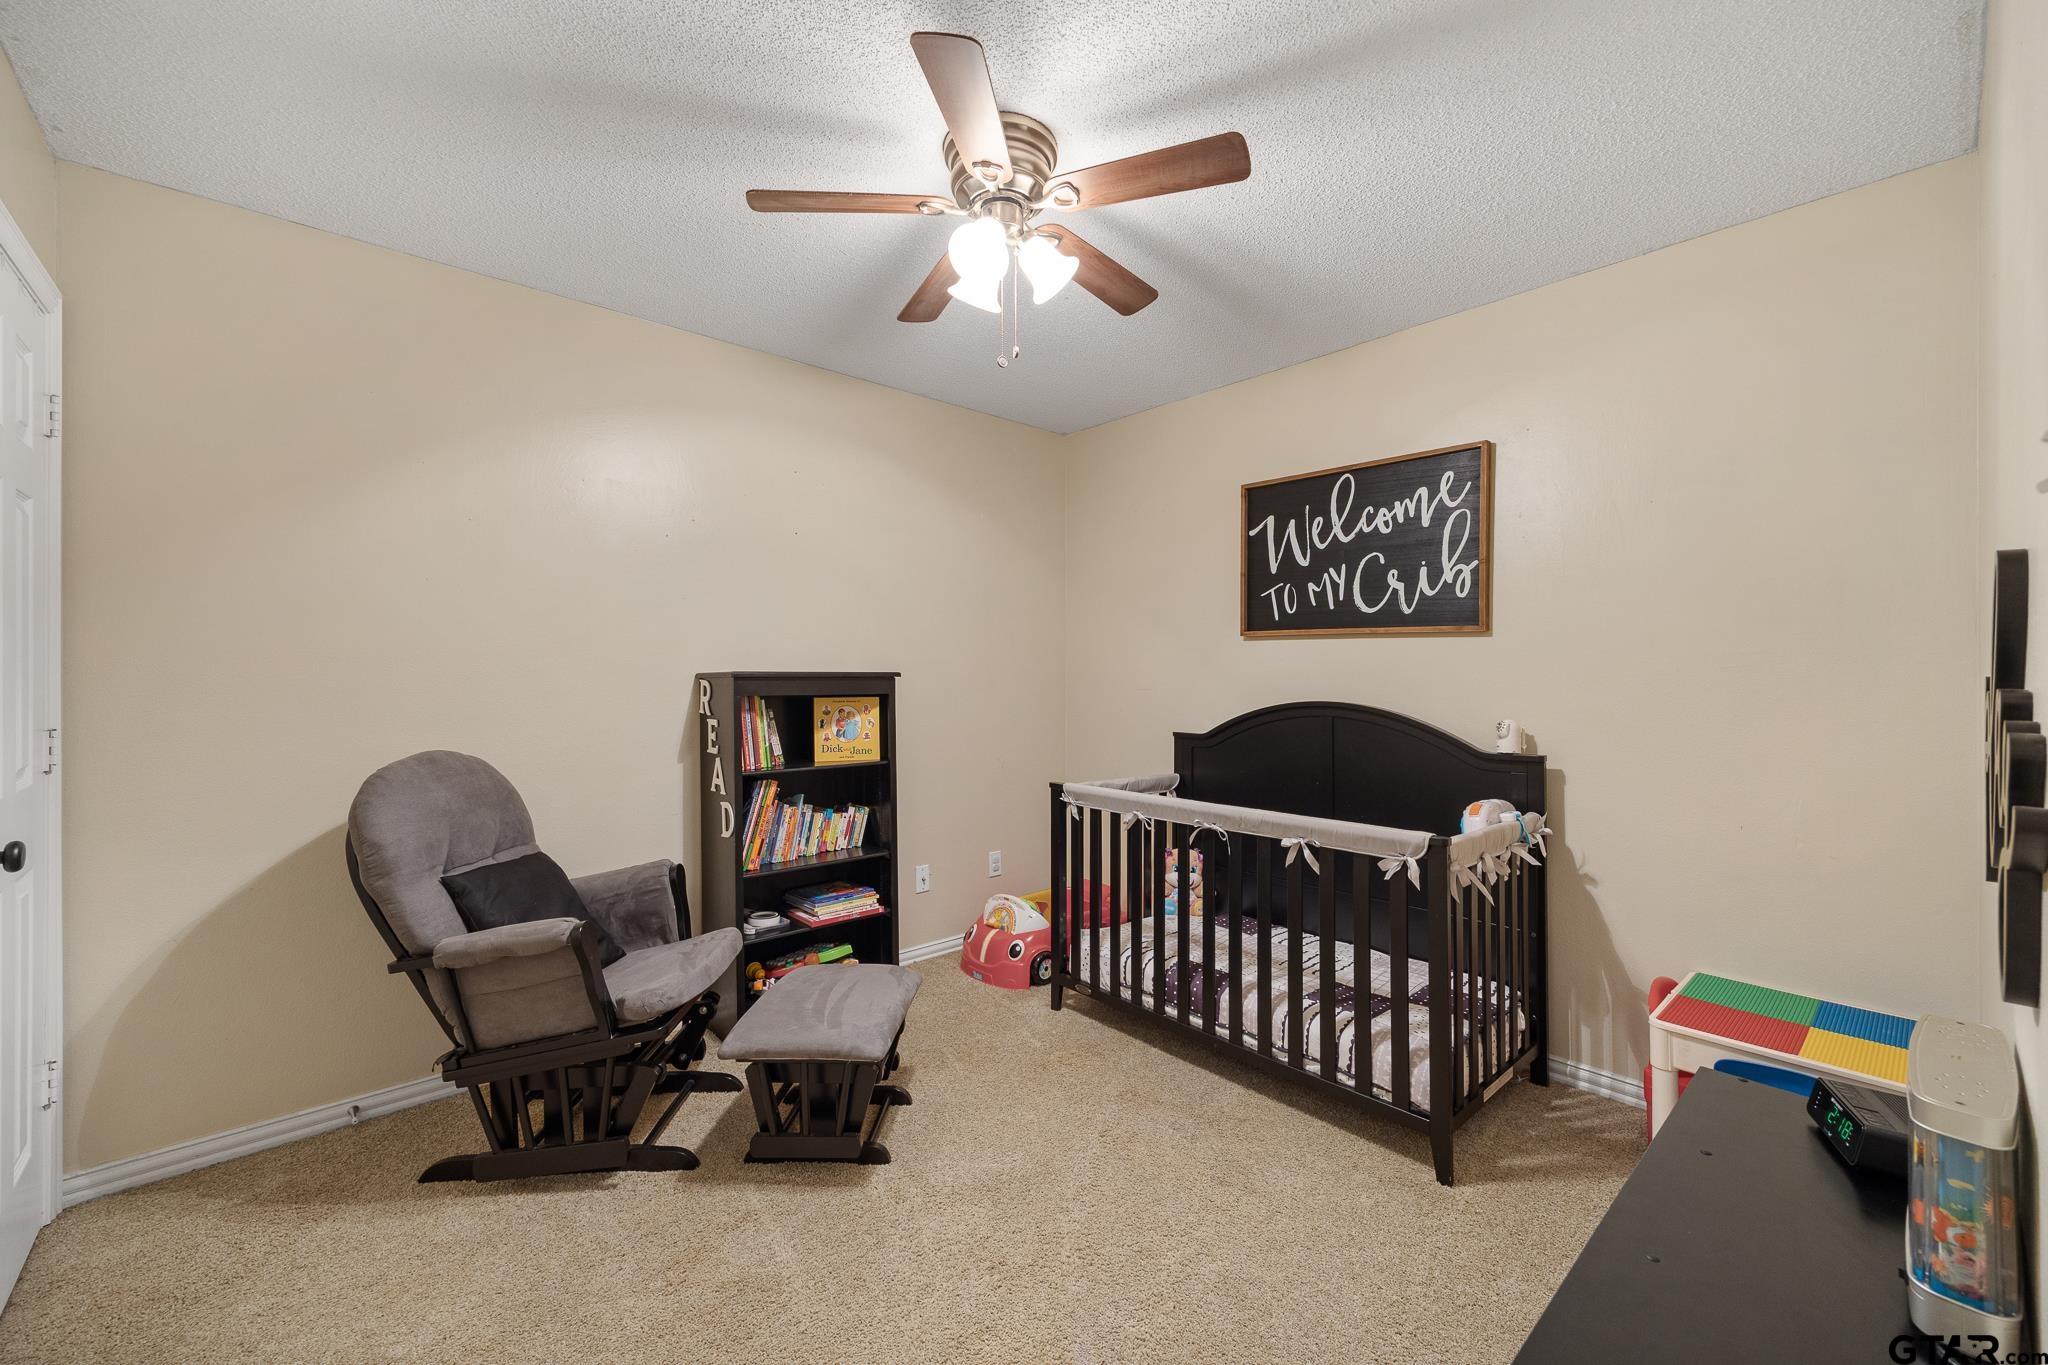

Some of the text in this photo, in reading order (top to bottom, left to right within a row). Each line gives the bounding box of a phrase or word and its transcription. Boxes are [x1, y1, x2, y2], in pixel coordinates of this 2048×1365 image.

[1249, 470, 1472, 574] Welcome
[1260, 508, 1479, 621] TO MY Crib
[698, 679, 735, 838] READ
[821, 744, 844, 753] Dick
[849, 745, 873, 755] Jane
